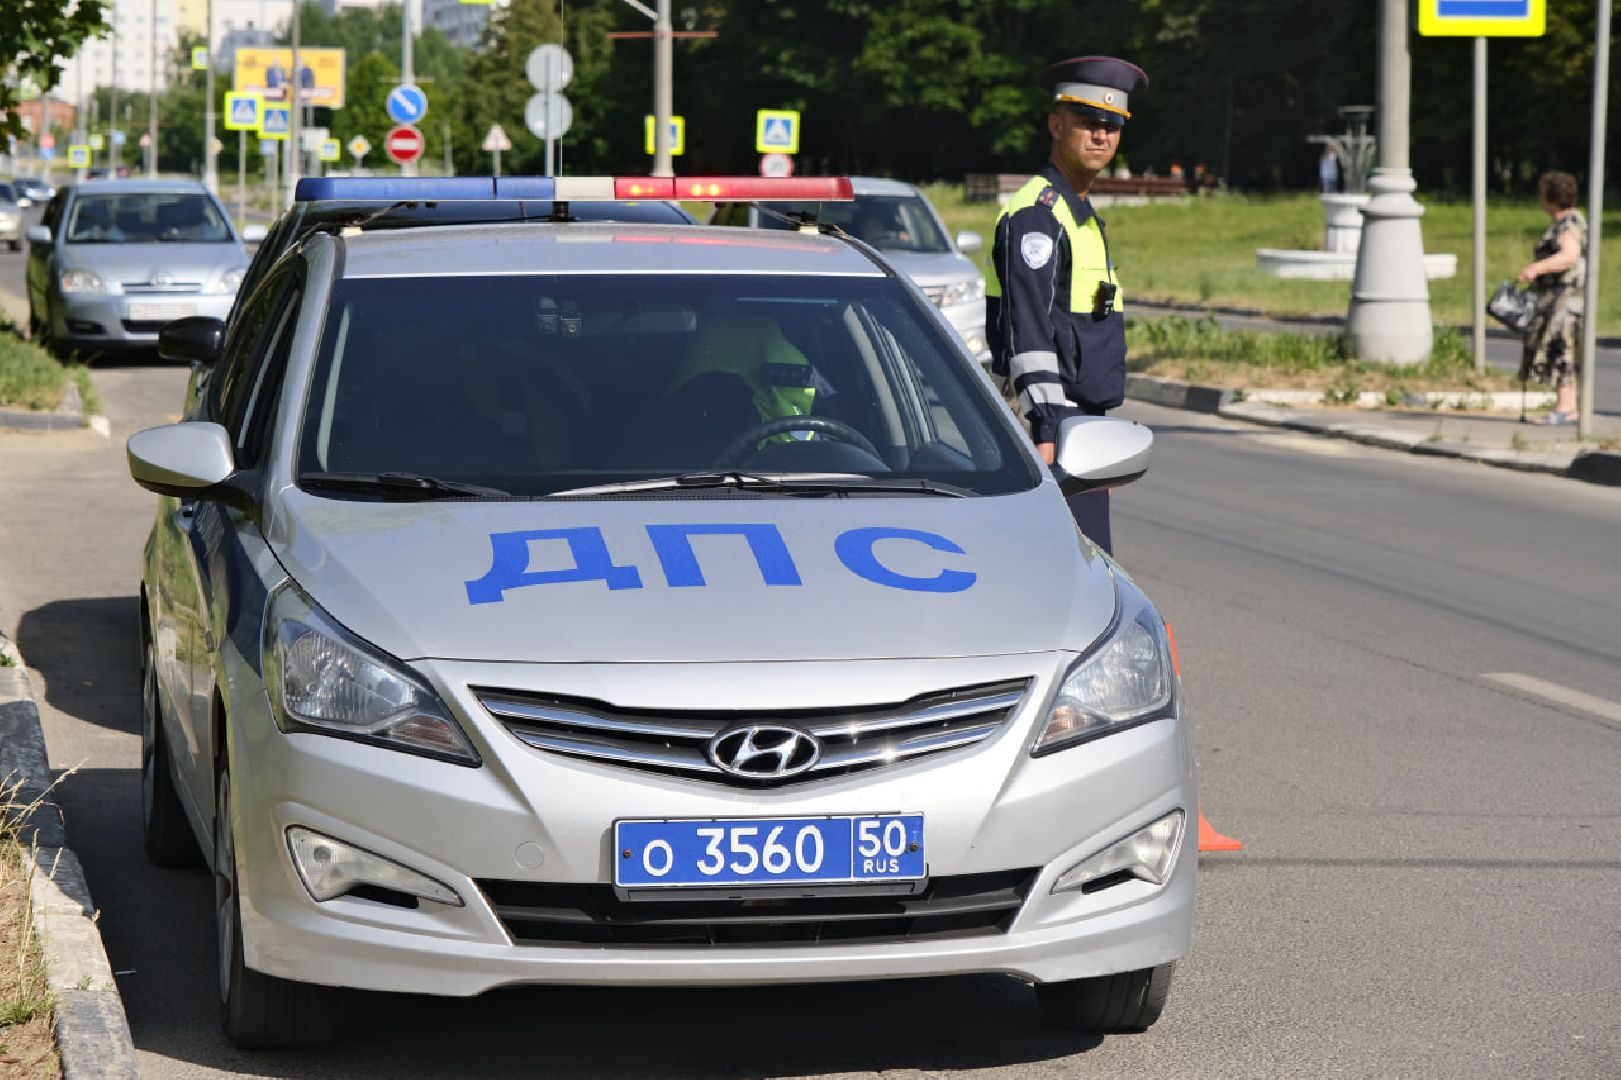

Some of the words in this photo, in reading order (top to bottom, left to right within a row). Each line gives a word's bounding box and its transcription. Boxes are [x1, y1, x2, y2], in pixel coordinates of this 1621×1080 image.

[464, 523, 977, 605] ДПС
[696, 824, 824, 876] 3560
[858, 819, 908, 858] 50
[863, 858, 900, 874] RUS
